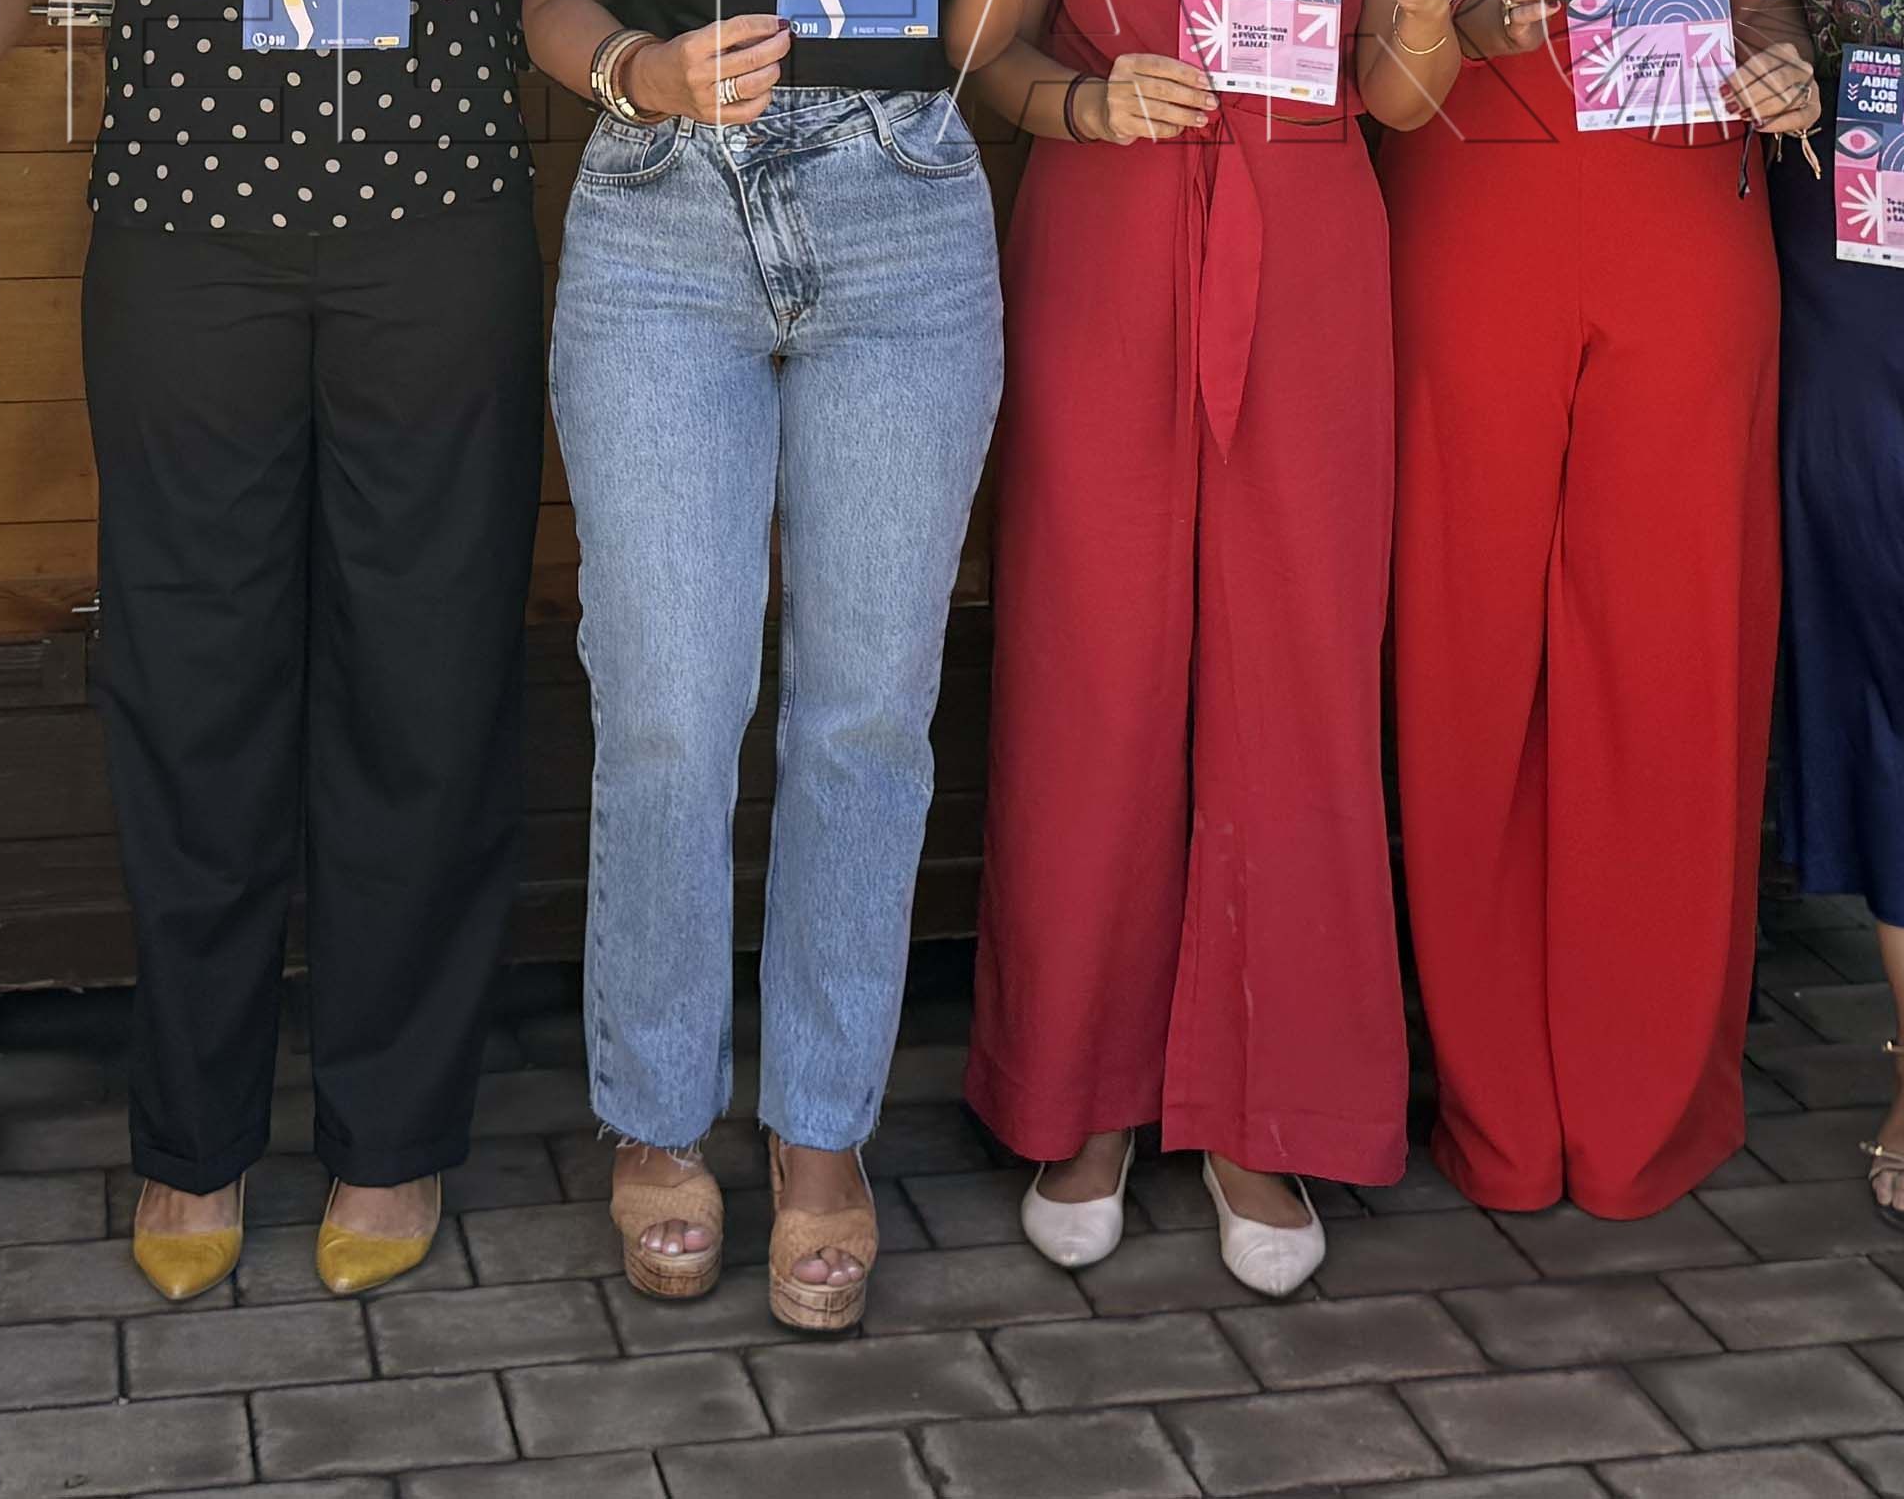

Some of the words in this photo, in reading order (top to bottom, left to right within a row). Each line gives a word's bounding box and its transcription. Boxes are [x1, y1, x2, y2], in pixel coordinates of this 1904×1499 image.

[1875, 51, 1901, 65] LAS
[1849, 63, 1902, 78] FIESTAS
[1862, 75, 1898, 90] ABRE
[1870, 88, 1897, 102] LOS
[1858, 100, 1898, 114] OJOS!
